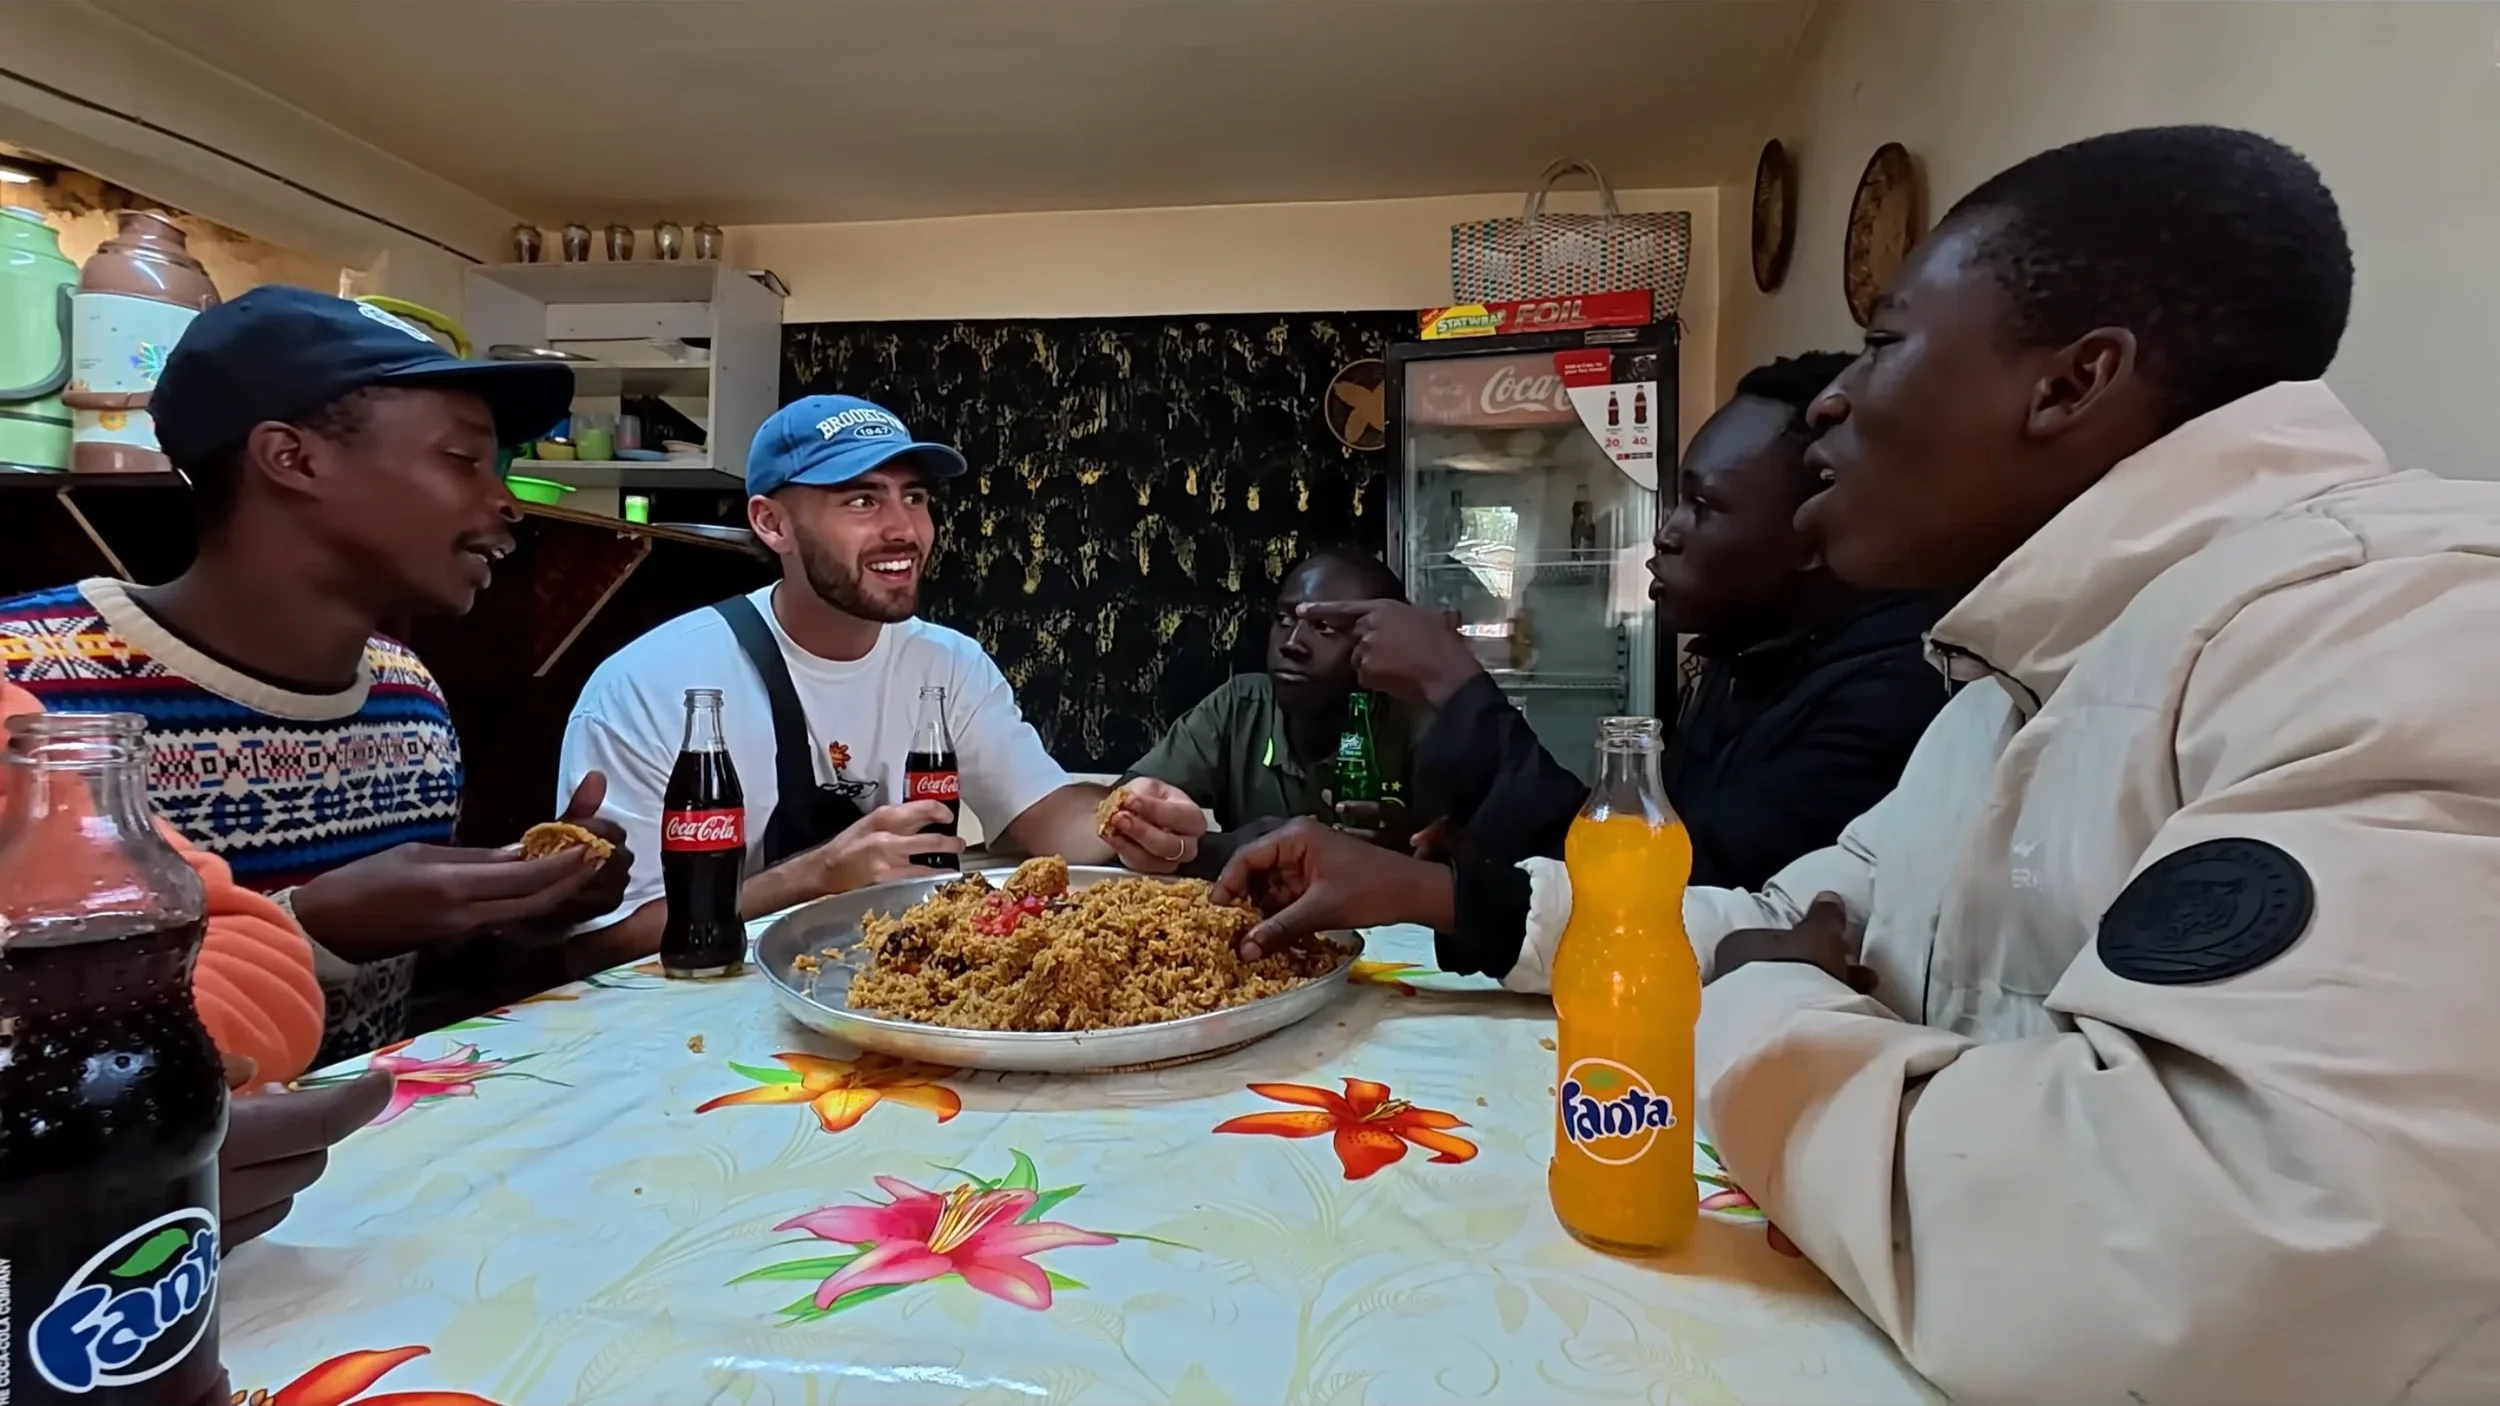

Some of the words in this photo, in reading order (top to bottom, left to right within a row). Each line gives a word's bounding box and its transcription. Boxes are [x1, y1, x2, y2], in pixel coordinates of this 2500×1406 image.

[1515, 299, 1588, 328] FOIL
[815, 408, 906, 440] BROOKLYN
[859, 426, 889, 437] 1947
[1605, 437, 1620, 448] 20
[1632, 435, 1648, 446] 40
[666, 814, 735, 842] Coca-Cola
[1560, 1078, 1673, 1144] Fanta
